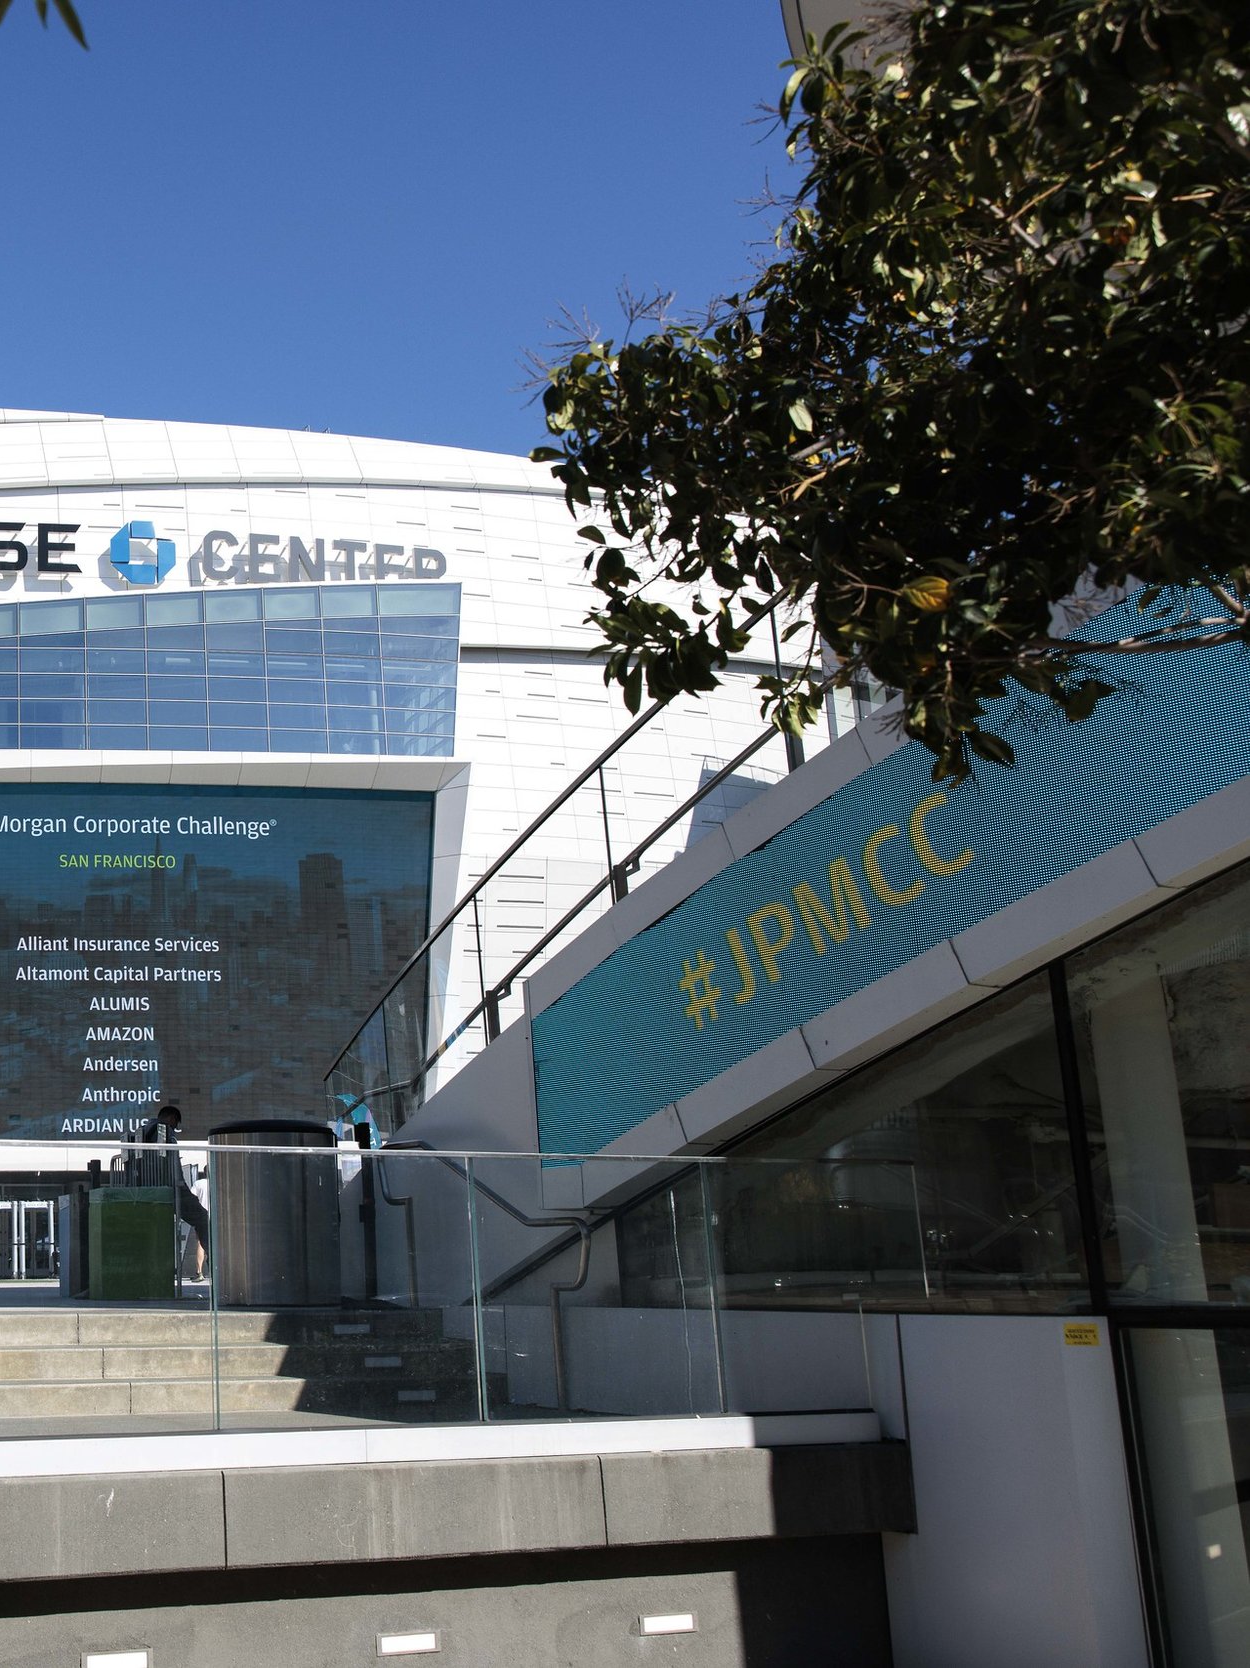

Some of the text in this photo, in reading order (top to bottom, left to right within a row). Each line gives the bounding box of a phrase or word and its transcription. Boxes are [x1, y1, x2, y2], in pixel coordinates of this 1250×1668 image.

[202, 530, 447, 583] CENTER
[73, 815, 171, 837] Corporate
[59, 854, 176, 869] SAN FRANCISCO
[678, 791, 976, 1030] #JPMCC
[17, 936, 220, 953] Alliant Insurance Services
[15, 966, 222, 984] Altamont Capital Partners
[89, 996, 150, 1011] ALUMIS
[85, 1027, 155, 1041] AMAZON
[83, 1056, 159, 1072] Andersen
[82, 1087, 161, 1104] Anthropic
[61, 1118, 124, 1133] ARDIAN
